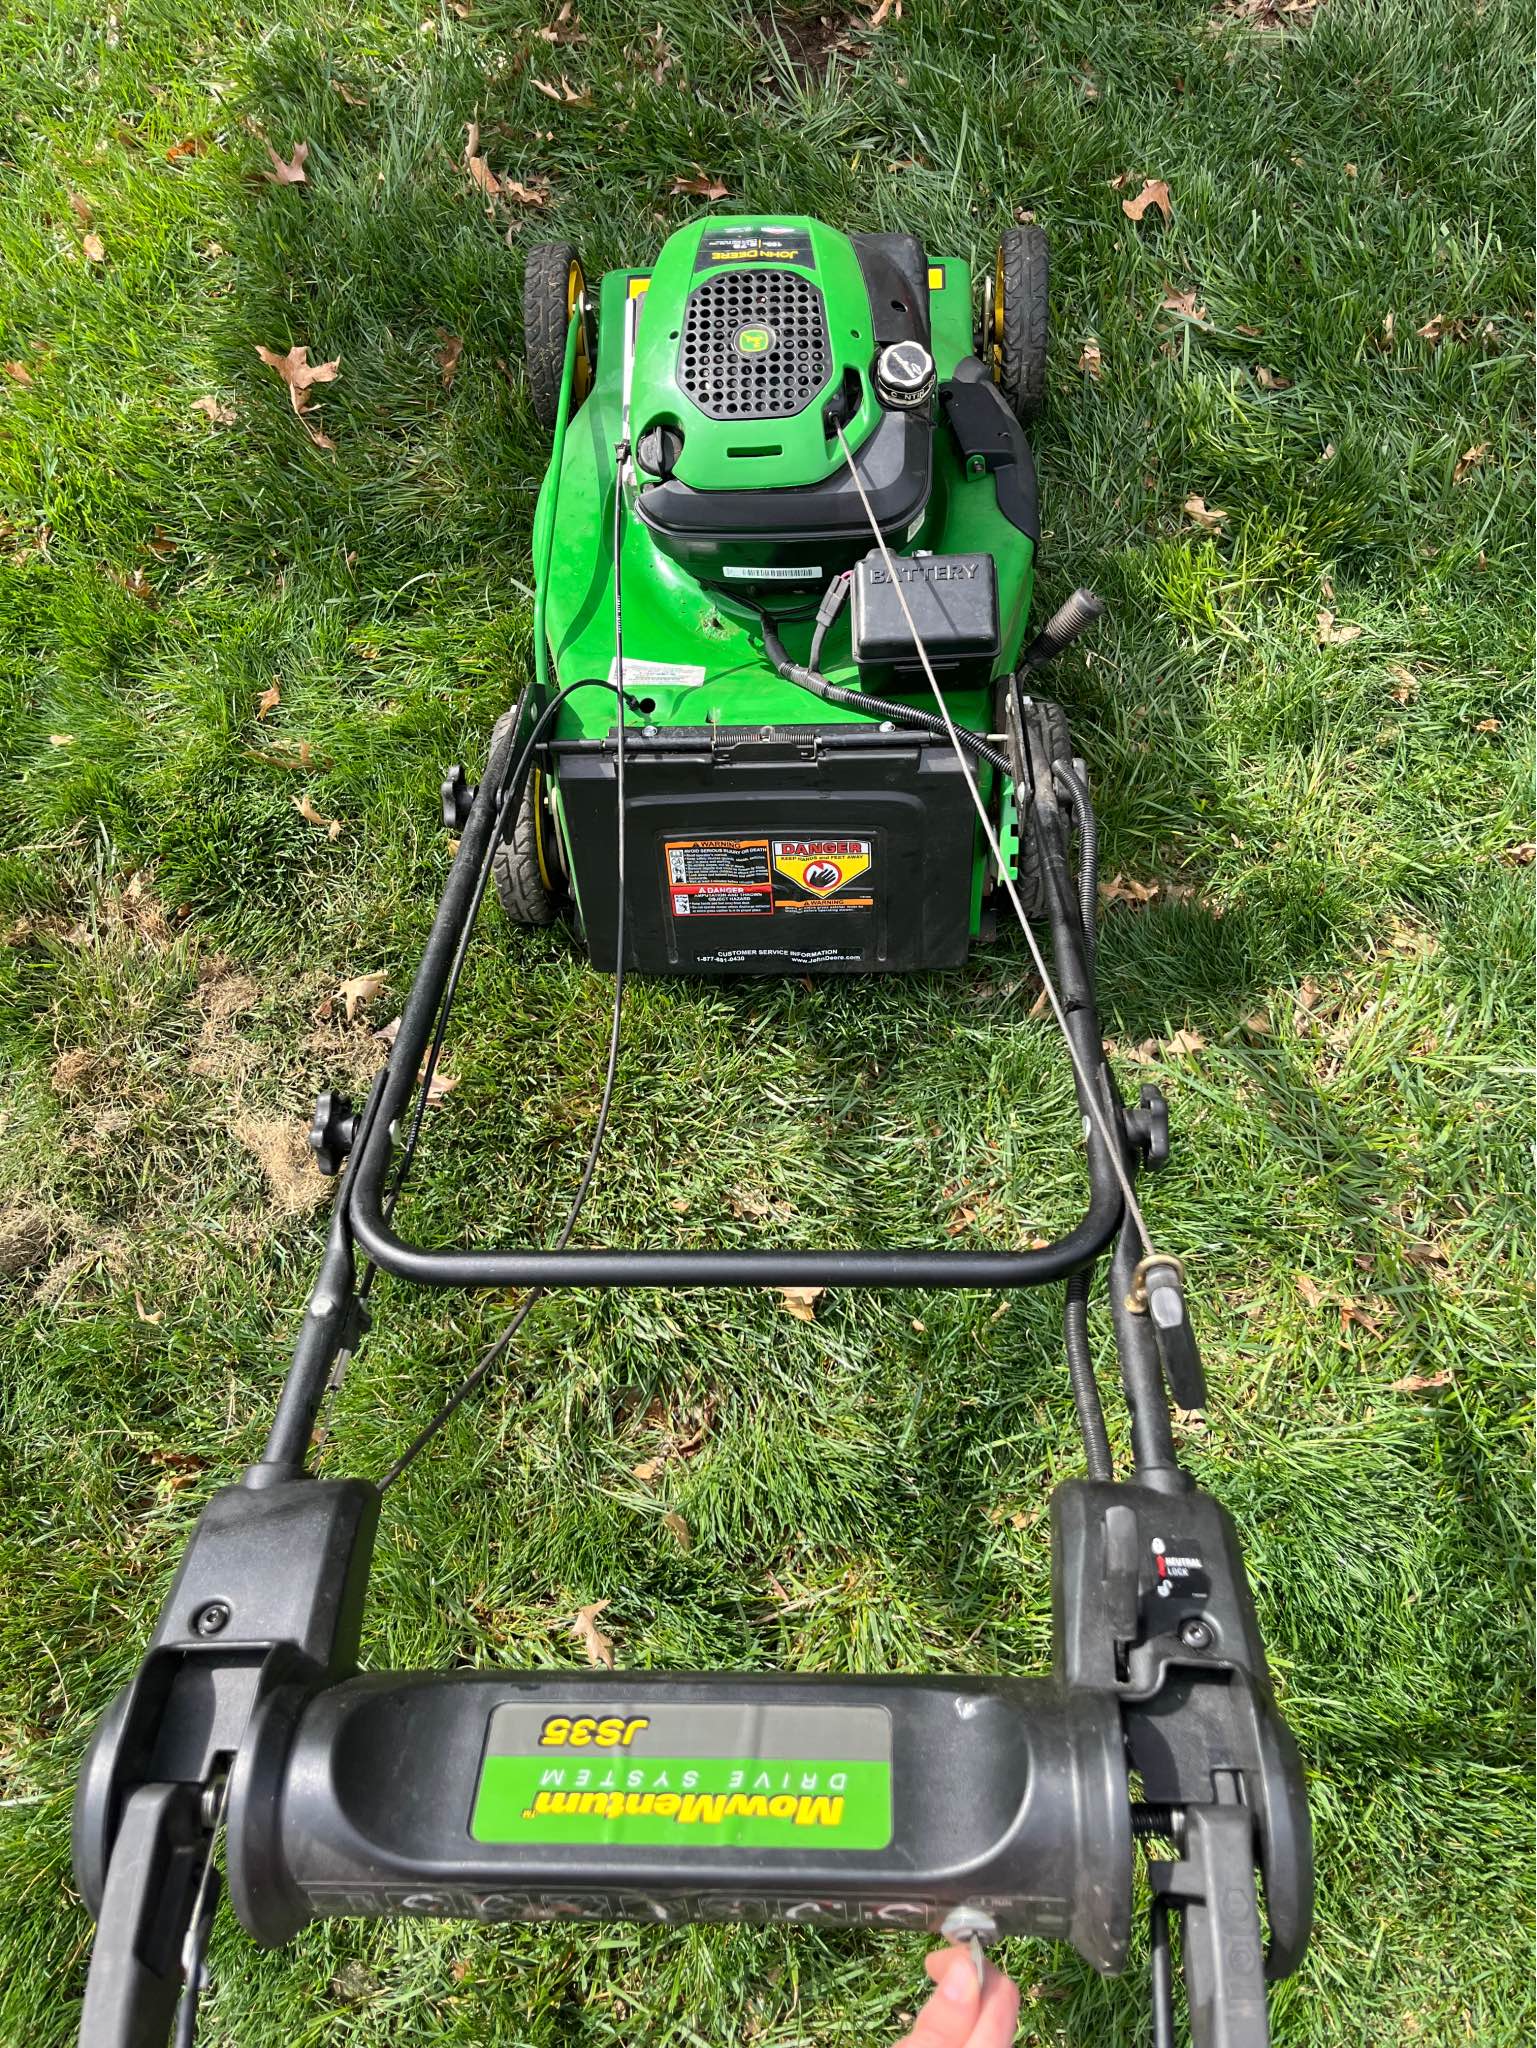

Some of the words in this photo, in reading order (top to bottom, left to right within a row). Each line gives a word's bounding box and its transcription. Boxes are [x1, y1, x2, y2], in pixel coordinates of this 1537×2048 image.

[712, 249, 758, 260] DEERE
[760, 250, 798, 259] JOHN
[870, 563, 979, 584] BATTERY
[700, 841, 740, 849] WARNING
[782, 843, 862, 855] DANGER
[789, 949, 838, 958] INFORMATION
[1165, 1557, 1203, 1568] NEUTRAL
[1167, 1567, 1189, 1576] LOCK
[538, 1714, 651, 1747] JS35
[540, 1769, 699, 1788] SYSTEM
[728, 1770, 847, 1790] DRIVE
